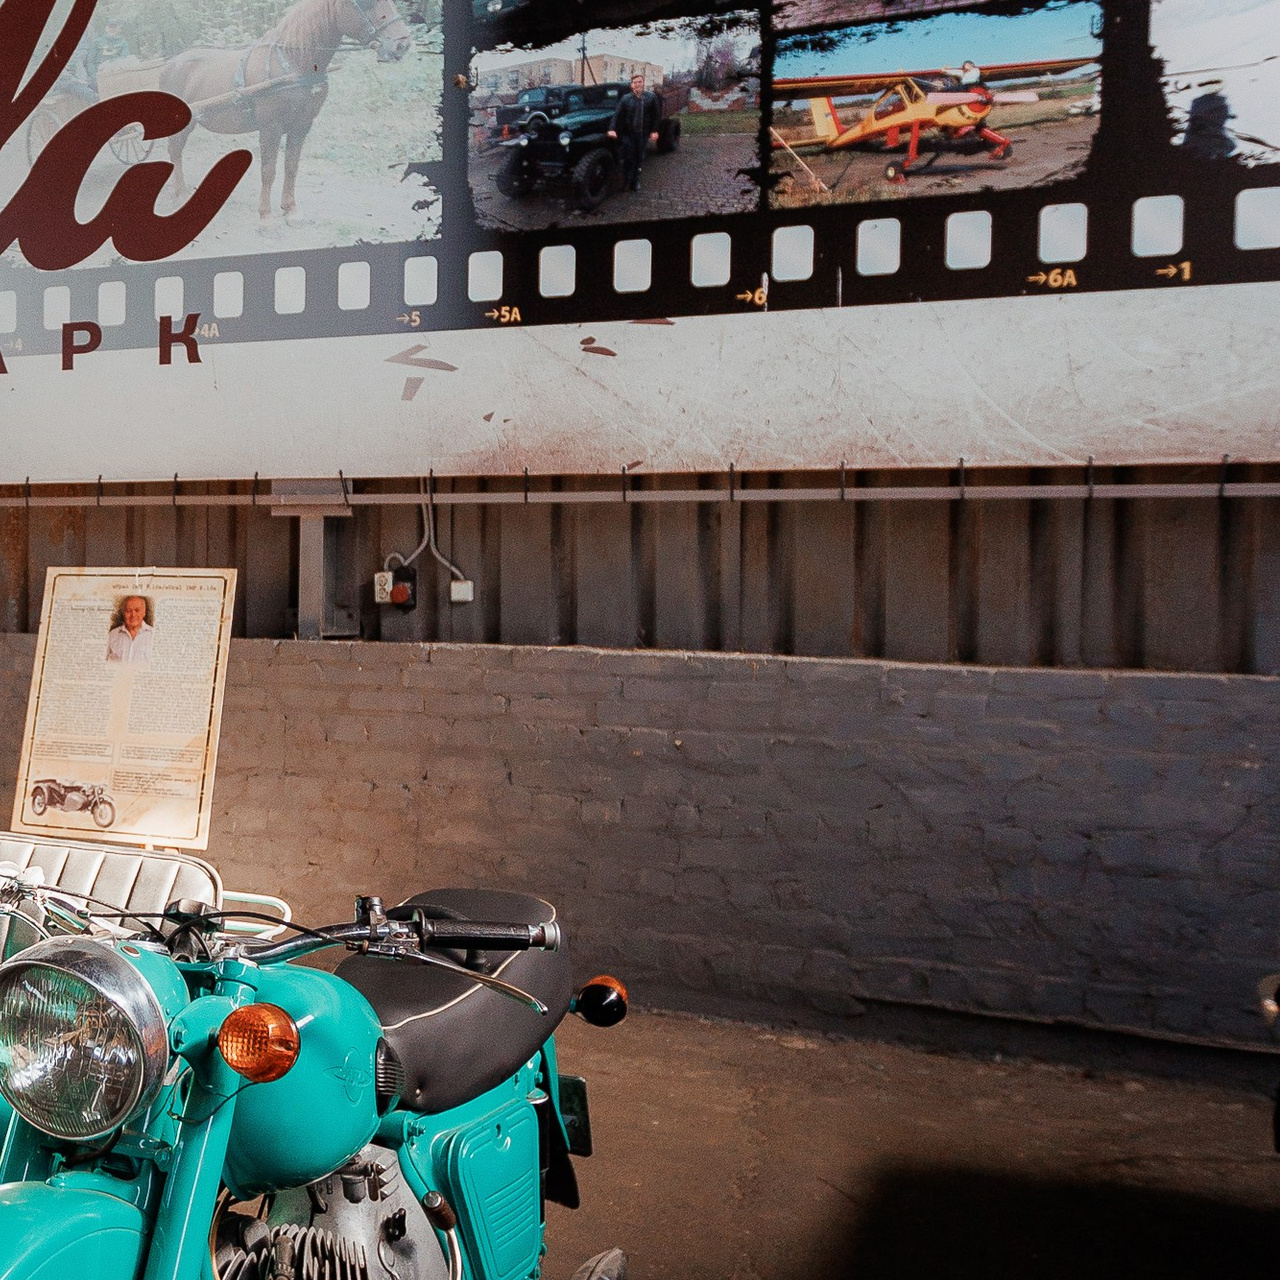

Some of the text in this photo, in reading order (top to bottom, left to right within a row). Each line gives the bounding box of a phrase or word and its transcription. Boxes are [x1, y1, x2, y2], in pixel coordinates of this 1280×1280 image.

[1049, 268, 1077, 288] 6A
[1179, 261, 1191, 281] 1
[755, 288, 768, 305] 6
[410, 310, 421, 327] 5
[500, 306, 521, 322] 5A
[200, 323, 220, 338] 4A
